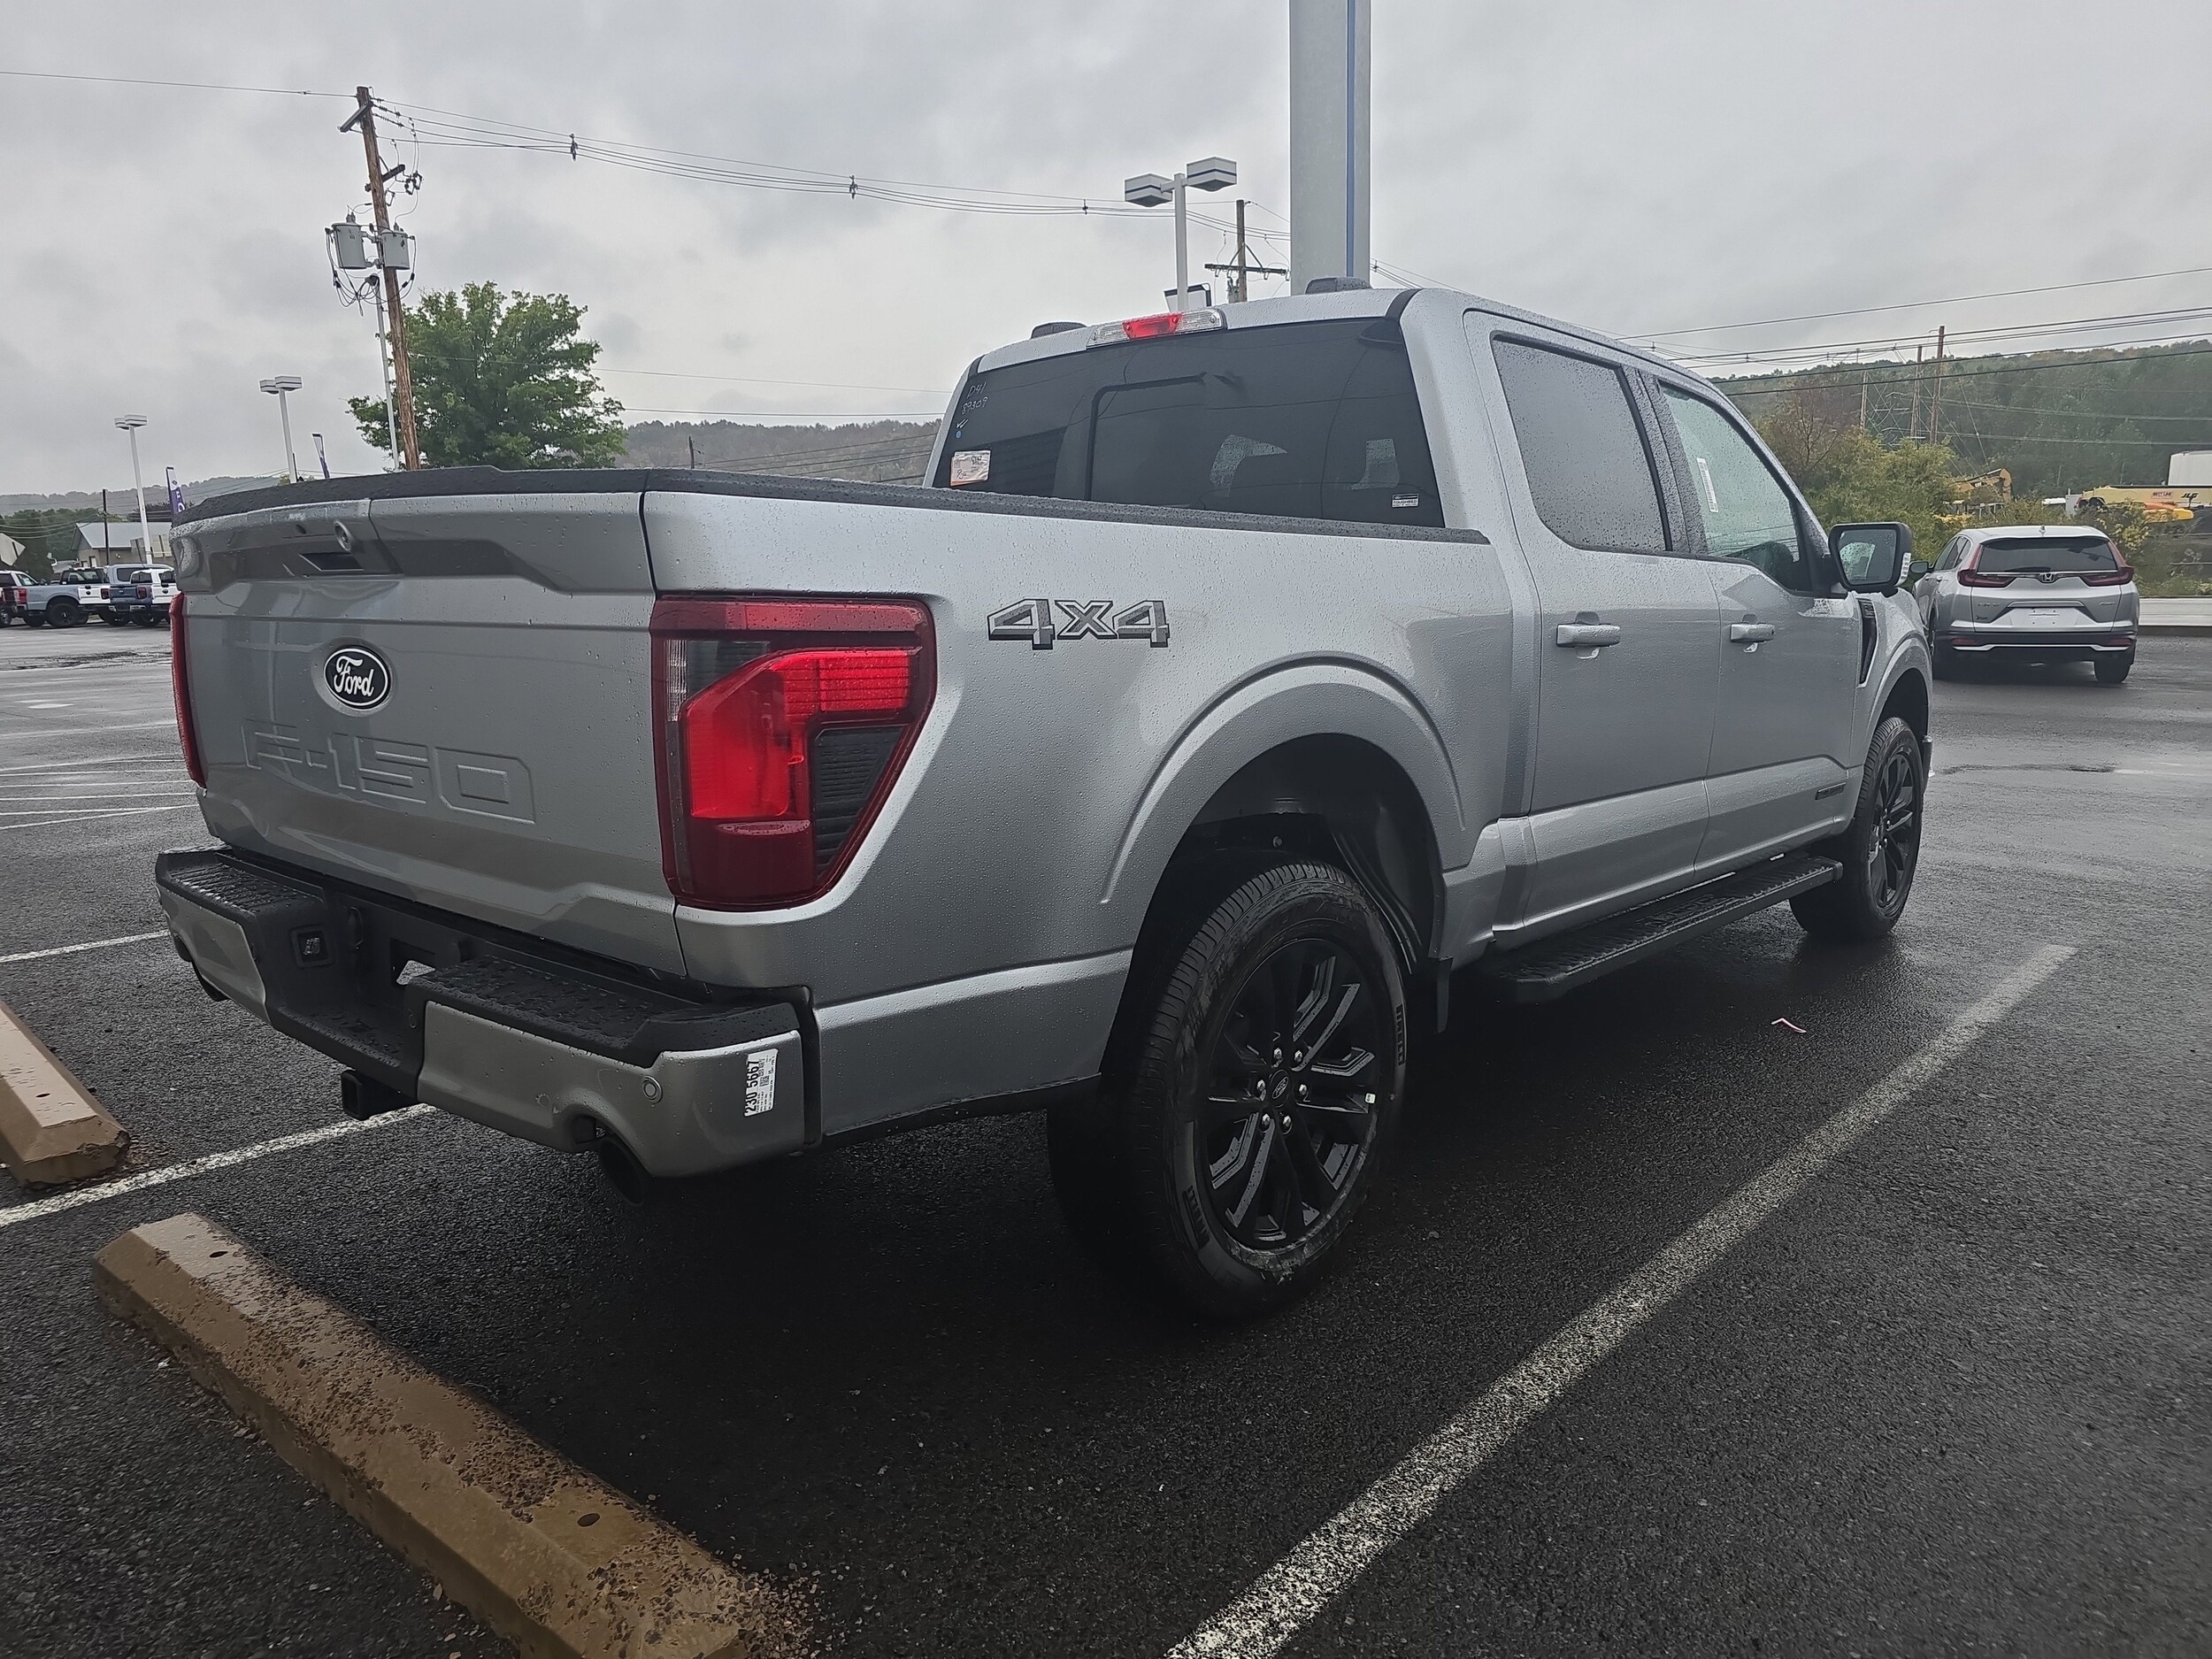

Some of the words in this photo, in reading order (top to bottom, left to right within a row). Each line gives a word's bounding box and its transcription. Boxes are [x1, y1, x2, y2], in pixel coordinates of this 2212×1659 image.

[334, 654, 375, 697] Ford
[241, 718, 535, 825] F-150
[747, 1061, 759, 1088] 5667
[745, 1092, 757, 1113] 230
